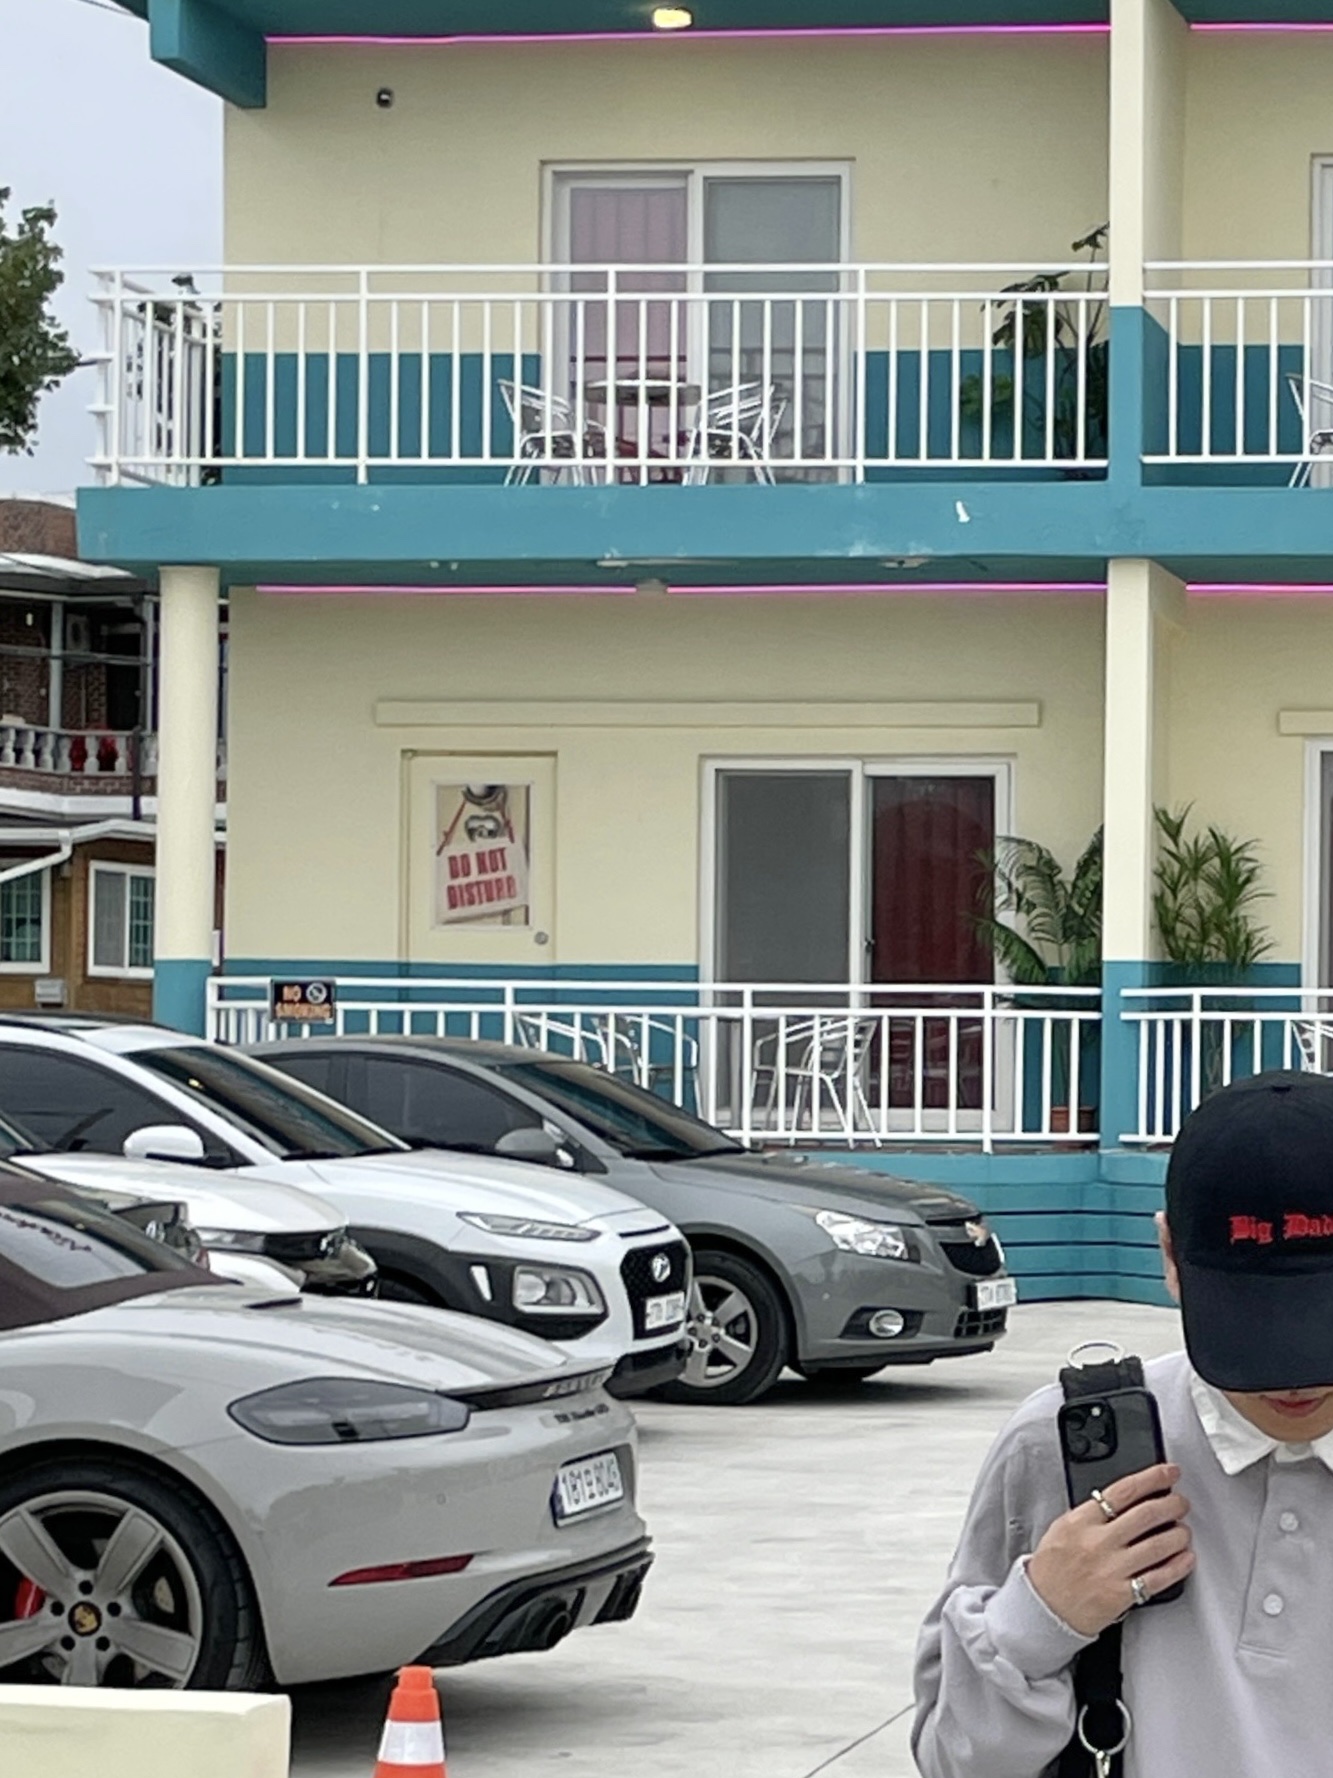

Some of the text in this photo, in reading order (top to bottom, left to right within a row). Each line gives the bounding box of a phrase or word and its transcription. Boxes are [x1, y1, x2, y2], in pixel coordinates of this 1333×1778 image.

[448, 847, 507, 880] DO NOT
[447, 875, 517, 910] DISTURB
[283, 985, 302, 1002] NO
[1229, 1215, 1273, 1245] Big
